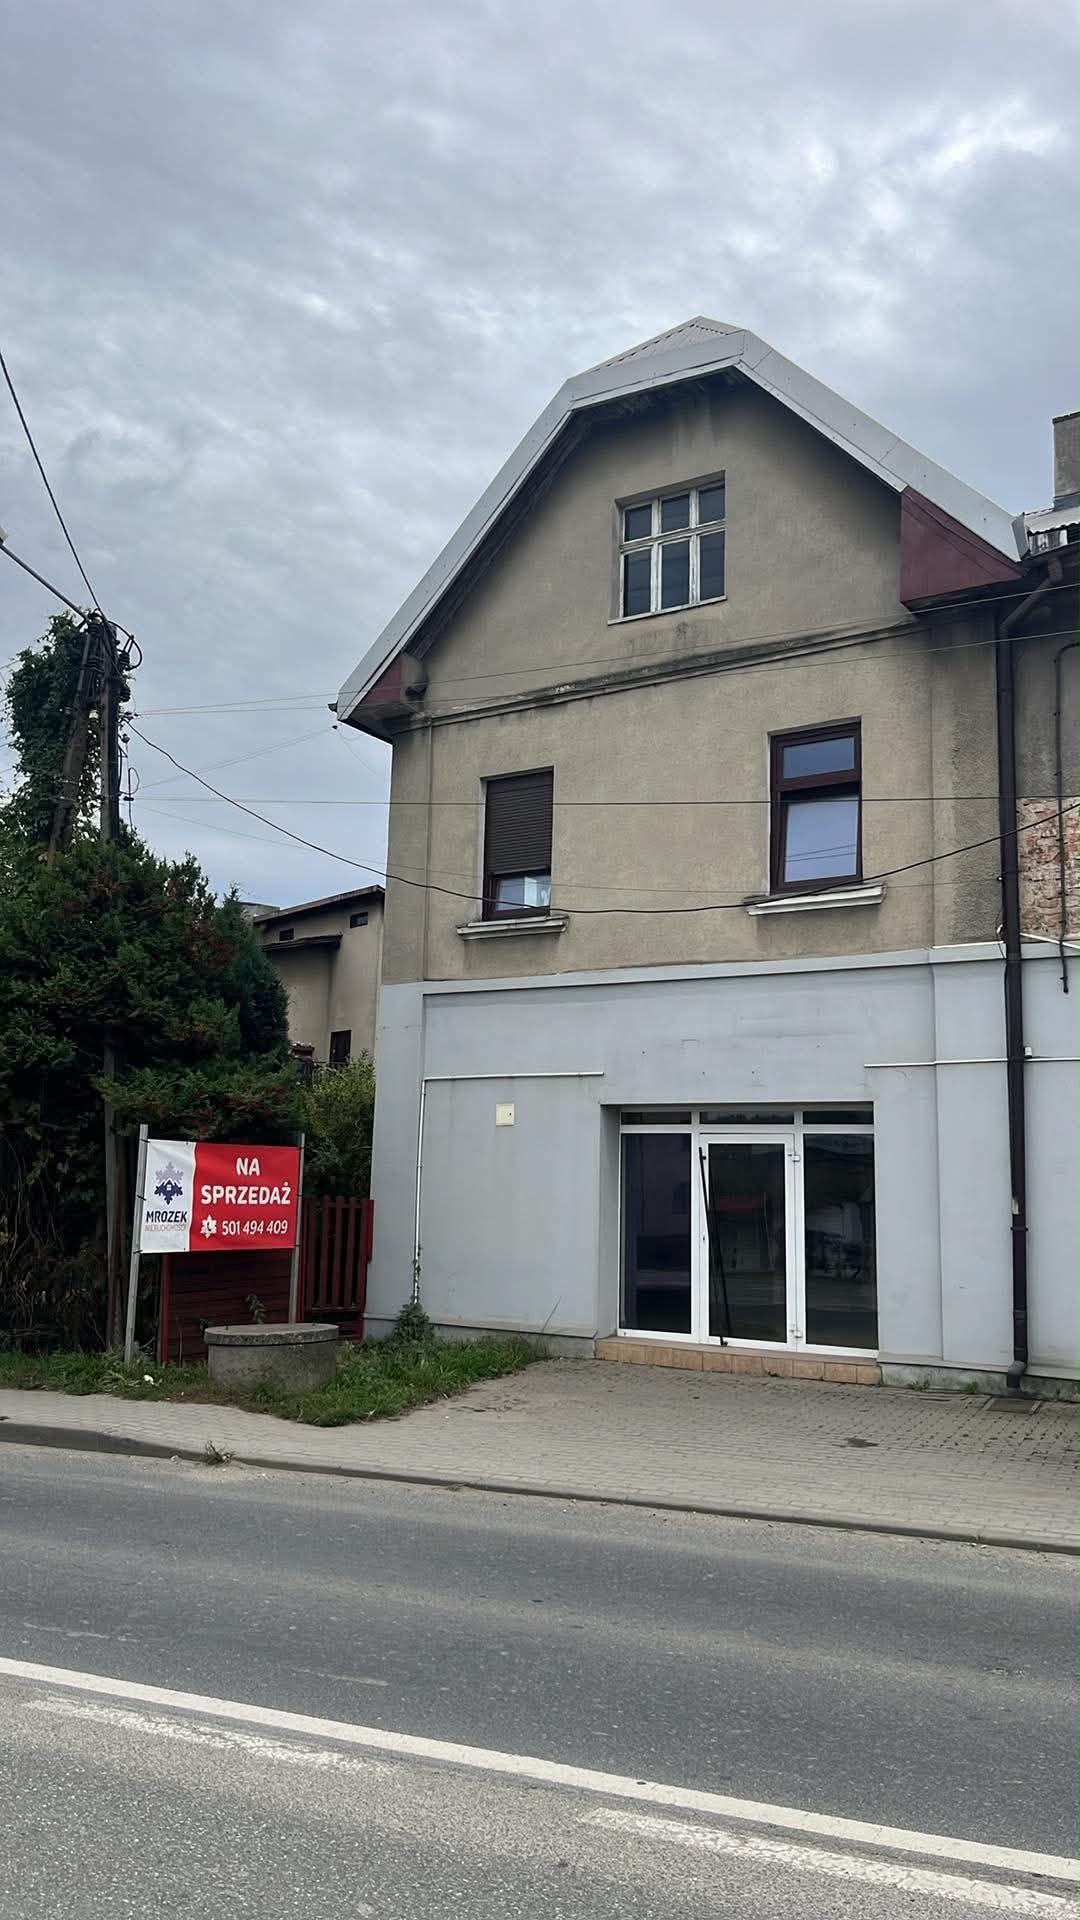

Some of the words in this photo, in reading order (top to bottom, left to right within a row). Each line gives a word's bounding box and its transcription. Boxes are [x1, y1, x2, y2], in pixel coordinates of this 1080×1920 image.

[236, 1157, 260, 1176] NA
[200, 1181, 291, 1205] SPRZEDAŻ
[146, 1210, 188, 1223] MROZEK
[221, 1220, 241, 1235] 501
[243, 1220, 264, 1235] 494
[266, 1219, 289, 1234] 409
